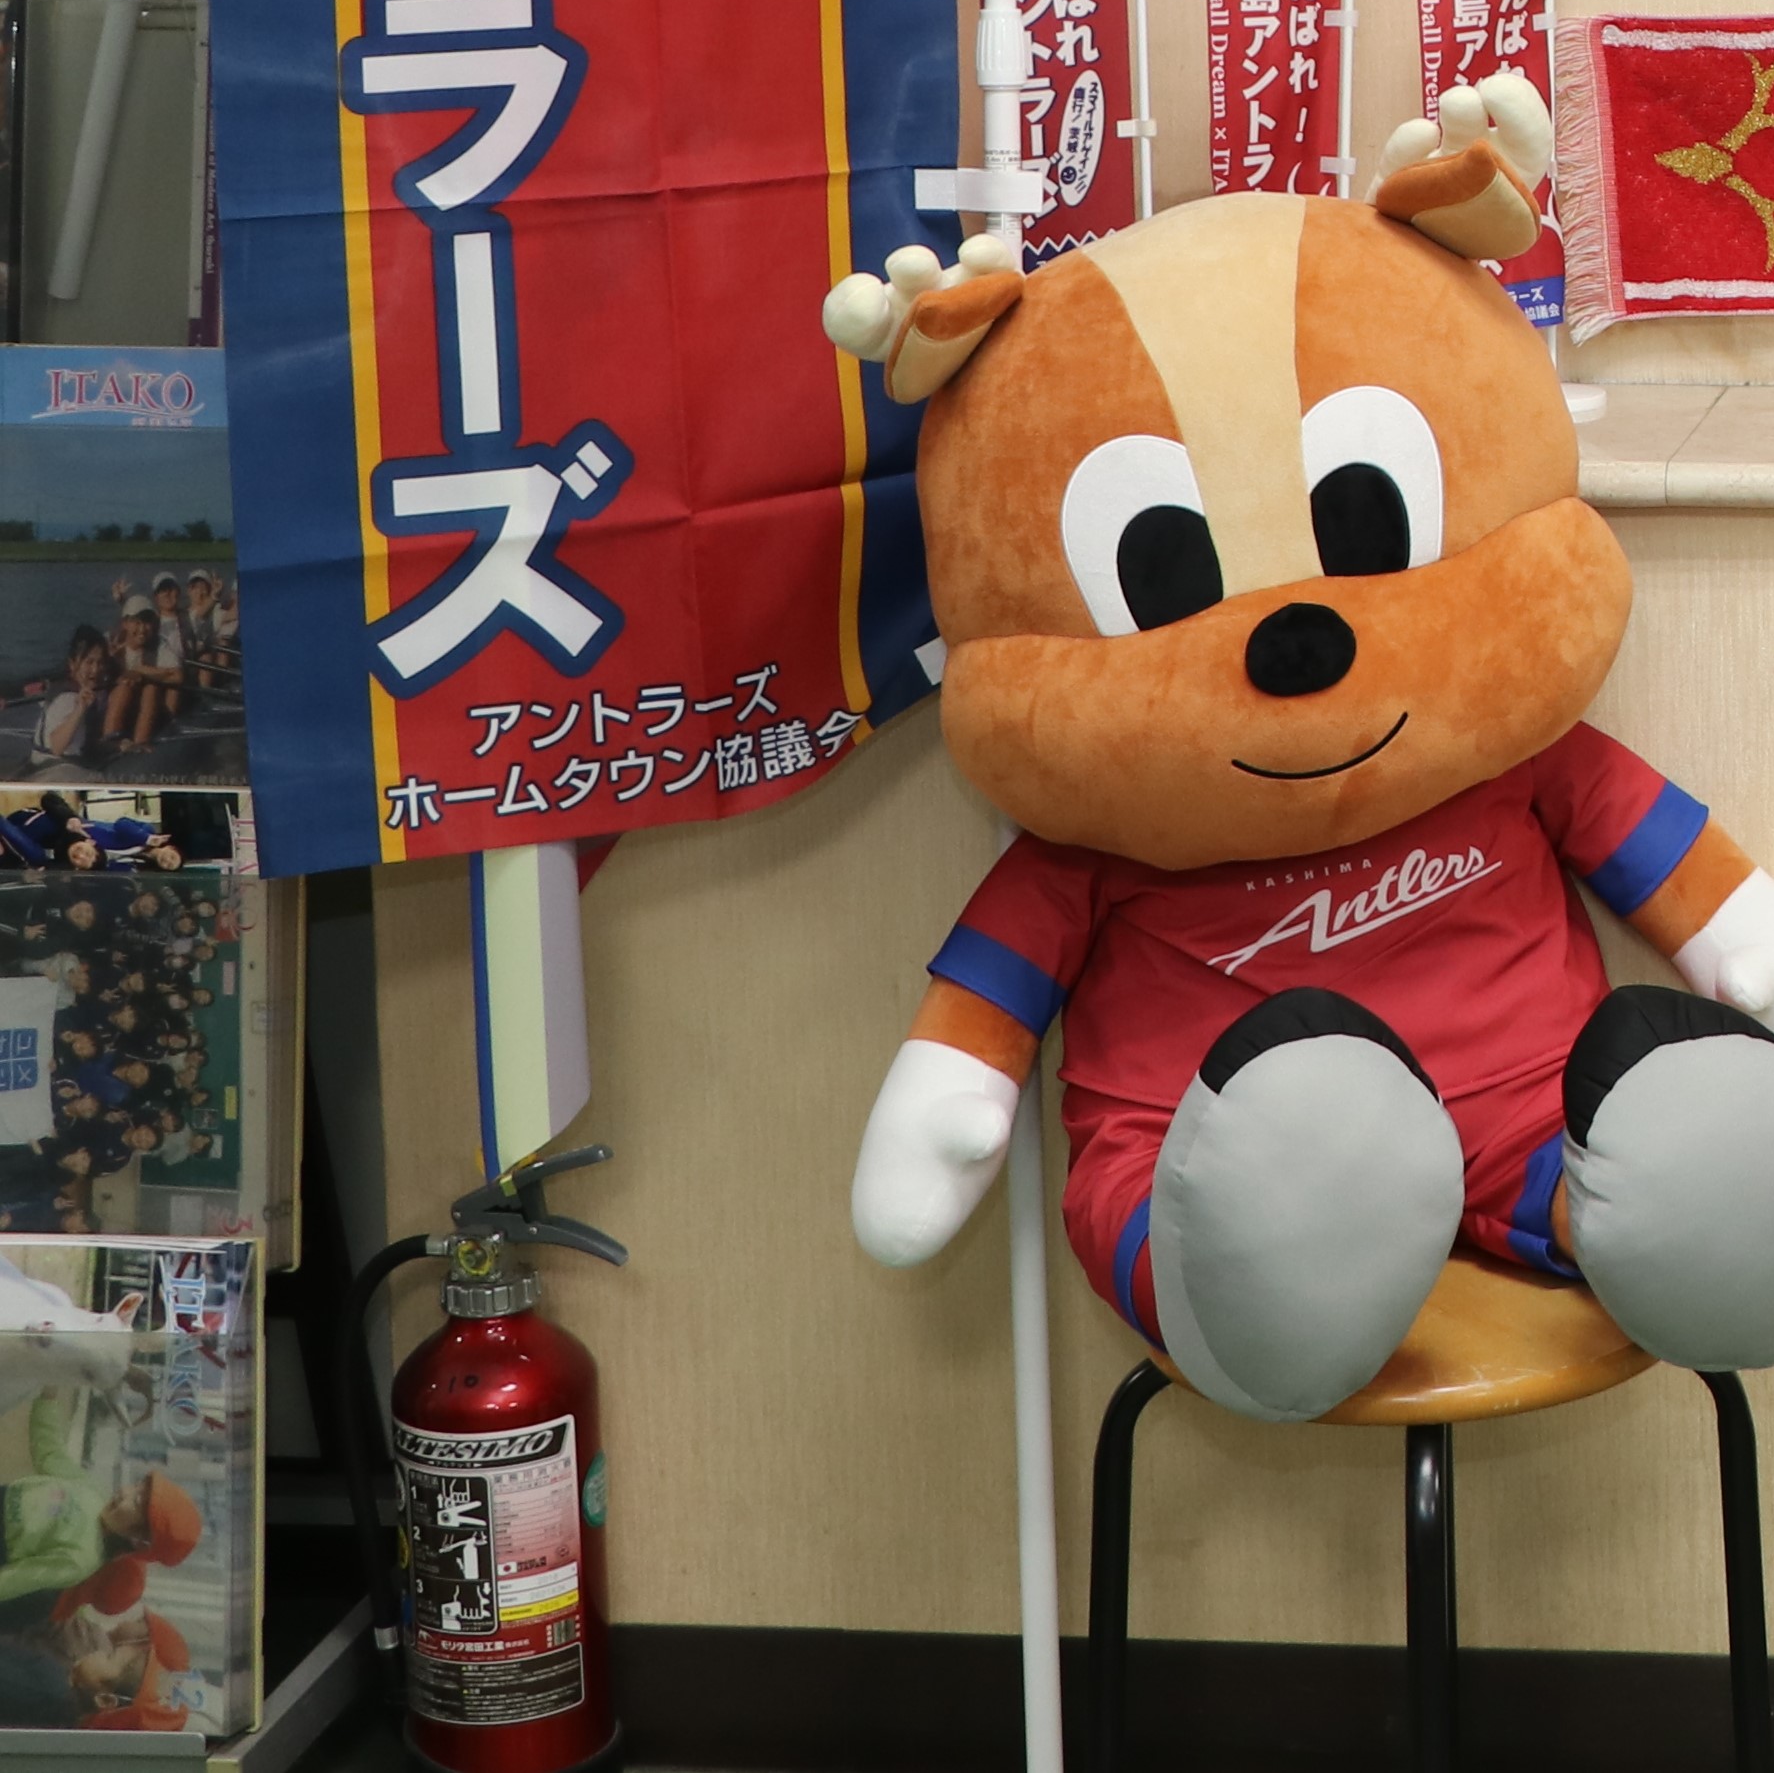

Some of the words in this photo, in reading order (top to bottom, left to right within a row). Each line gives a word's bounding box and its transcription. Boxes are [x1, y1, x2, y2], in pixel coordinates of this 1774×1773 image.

[1209, 32, 1227, 120] Dream
[46, 370, 196, 414] ITAKO
[468, 664, 778, 754] アントラーズ
[385, 711, 862, 831] ホームタウン協議会
[1206, 846, 1502, 976] Antlers
[1247, 859, 1372, 891] KASHIMA
